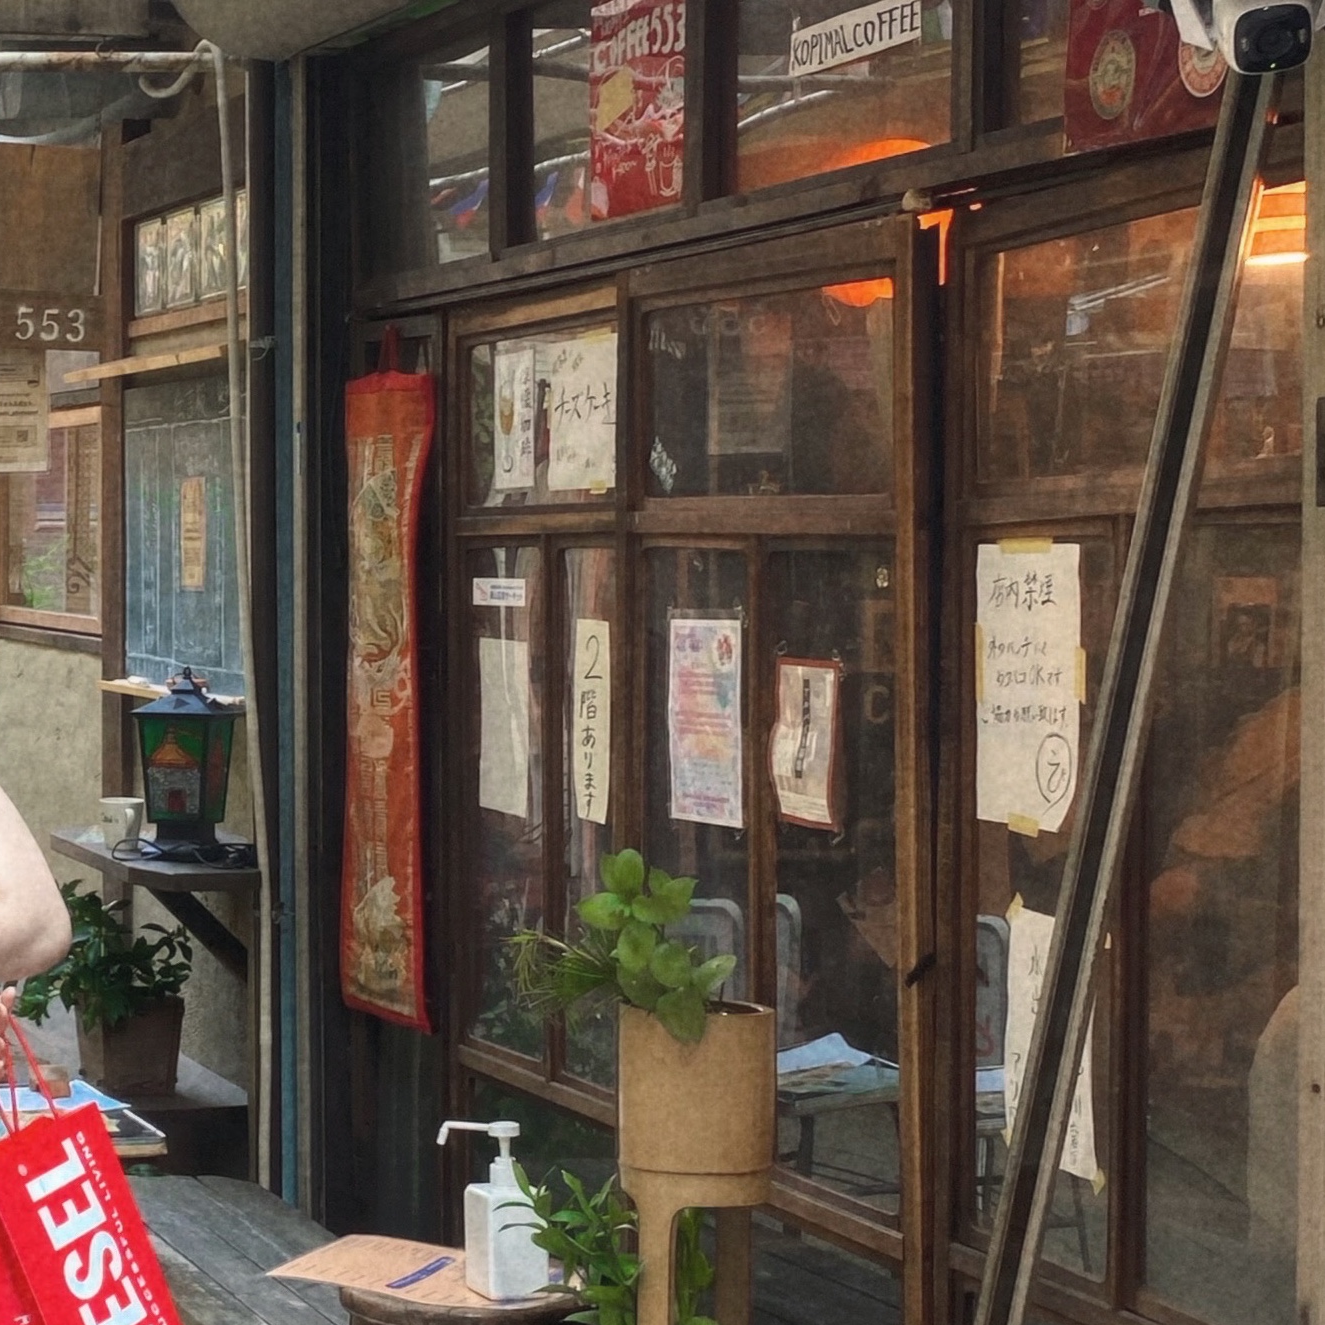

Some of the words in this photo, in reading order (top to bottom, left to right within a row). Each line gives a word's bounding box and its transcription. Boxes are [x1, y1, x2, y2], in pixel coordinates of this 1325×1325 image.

[791, 25, 854, 71] KOPIMAL
[853, 1, 920, 47] COFFEE
[15, 306, 85, 343] 553
[579, 634, 604, 818] 2階あります
[75, 1130, 112, 1202] LIVING
